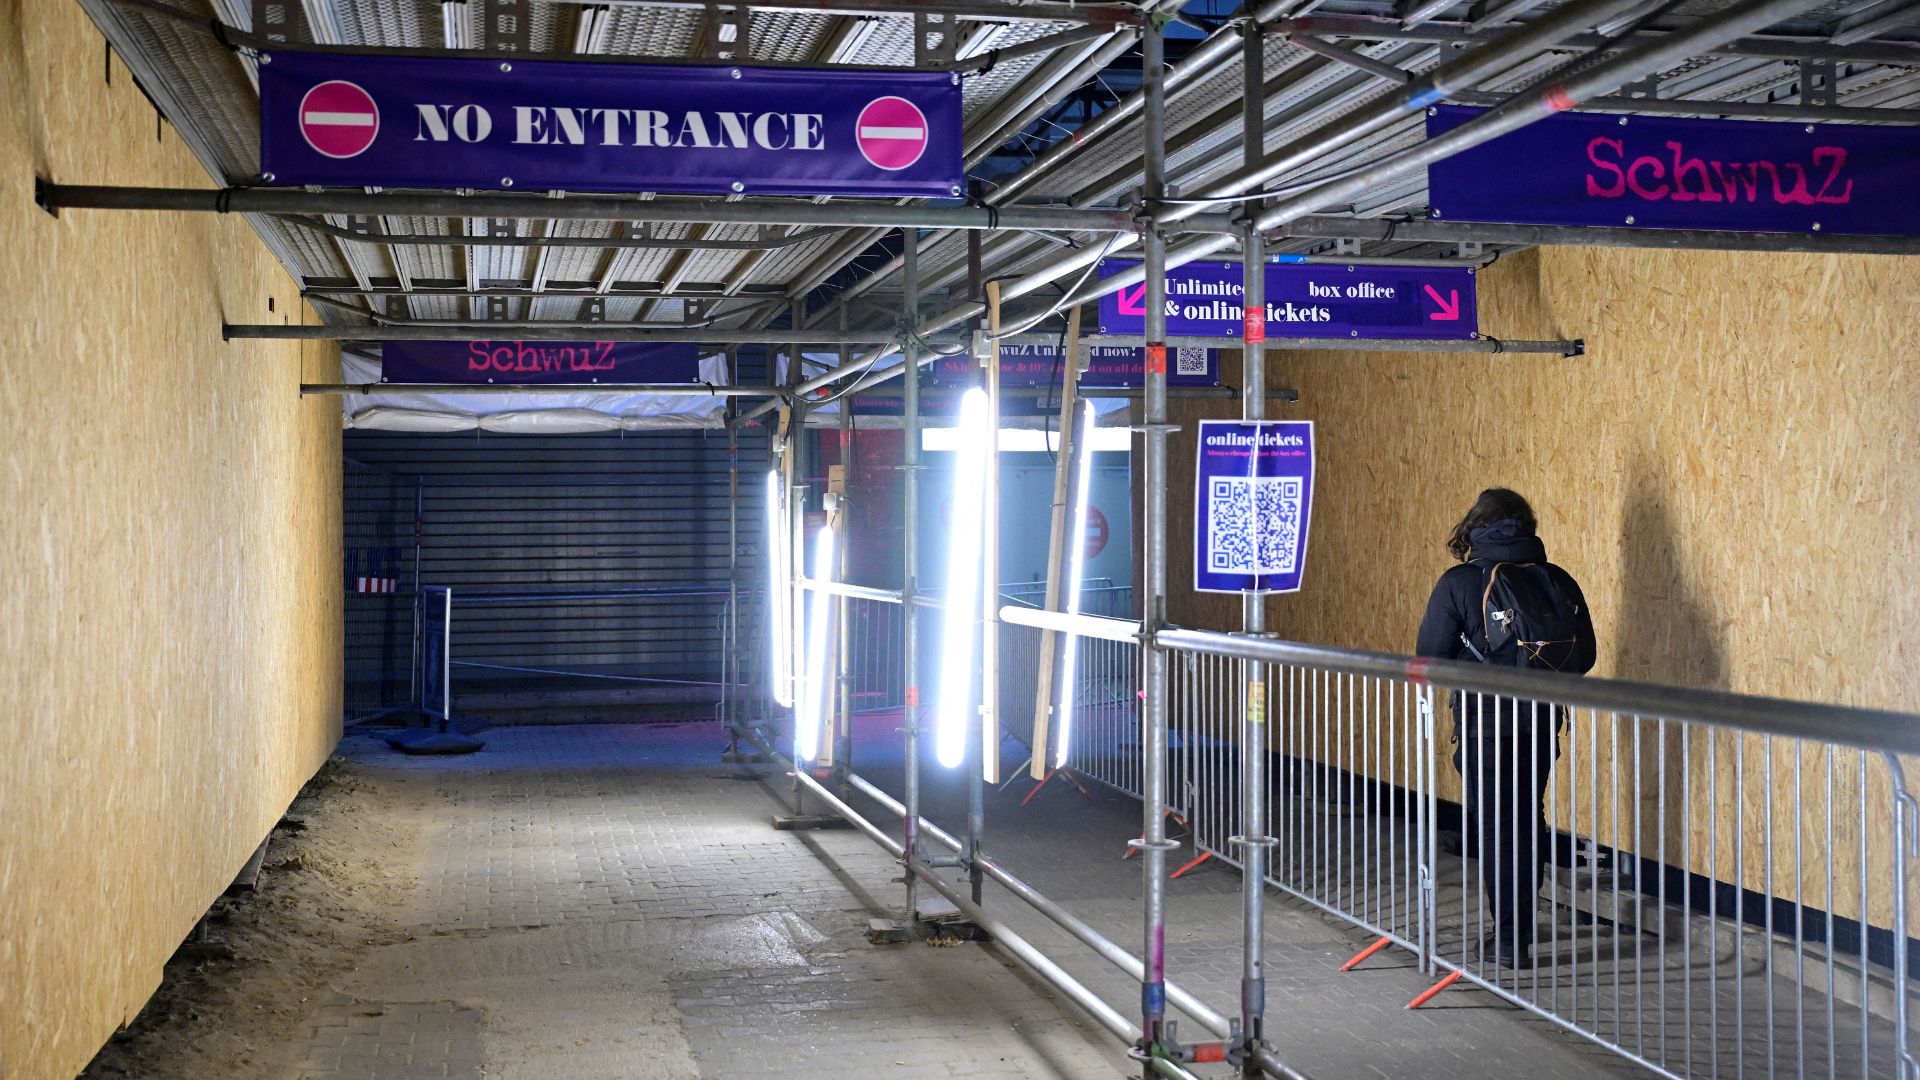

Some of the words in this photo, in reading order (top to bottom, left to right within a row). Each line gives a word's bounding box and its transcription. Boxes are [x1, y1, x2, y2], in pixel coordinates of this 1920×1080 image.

[413, 103, 493, 144] NO
[512, 105, 825, 151] ENTRANCE
[1586, 136, 1853, 205] SchwuZ
[1164, 278, 1246, 296] Unlimite
[1308, 281, 1342, 298] box
[1346, 282, 1395, 299] office
[1164, 300, 1180, 317] &
[1183, 300, 1246, 320] onlin
[1263, 302, 1331, 322] ickets
[468, 340, 616, 372] SchwuZ
[1206, 432, 1255, 446] online
[1258, 432, 1304, 447] tickets
